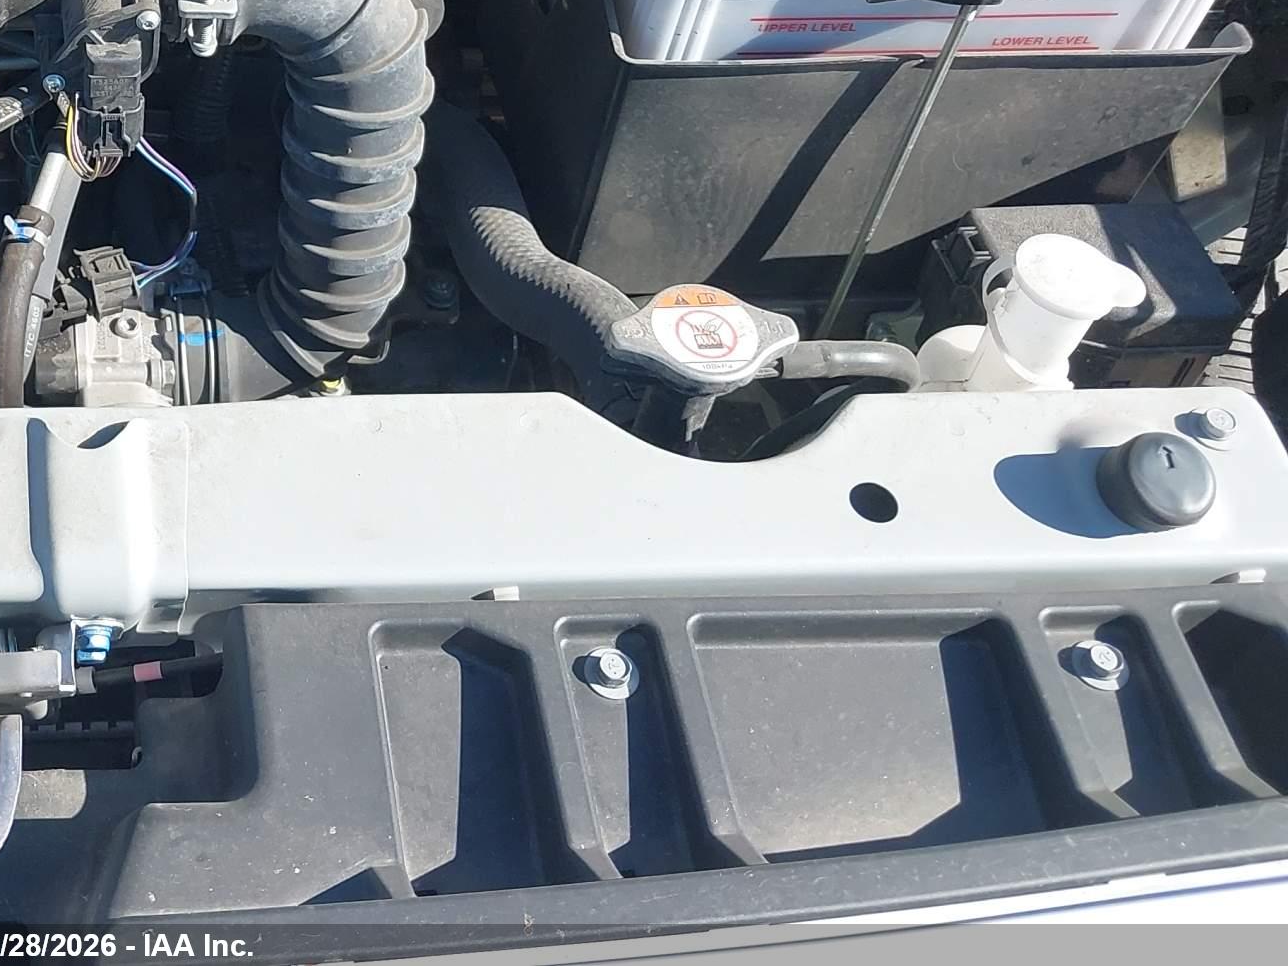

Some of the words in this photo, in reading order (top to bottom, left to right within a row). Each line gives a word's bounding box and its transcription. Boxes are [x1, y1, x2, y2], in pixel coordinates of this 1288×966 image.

[758, 22, 810, 33] UPPER
[811, 22, 857, 33] LEVEL
[992, 36, 1043, 47] LOWER
[1047, 36, 1092, 46] LEVEL
